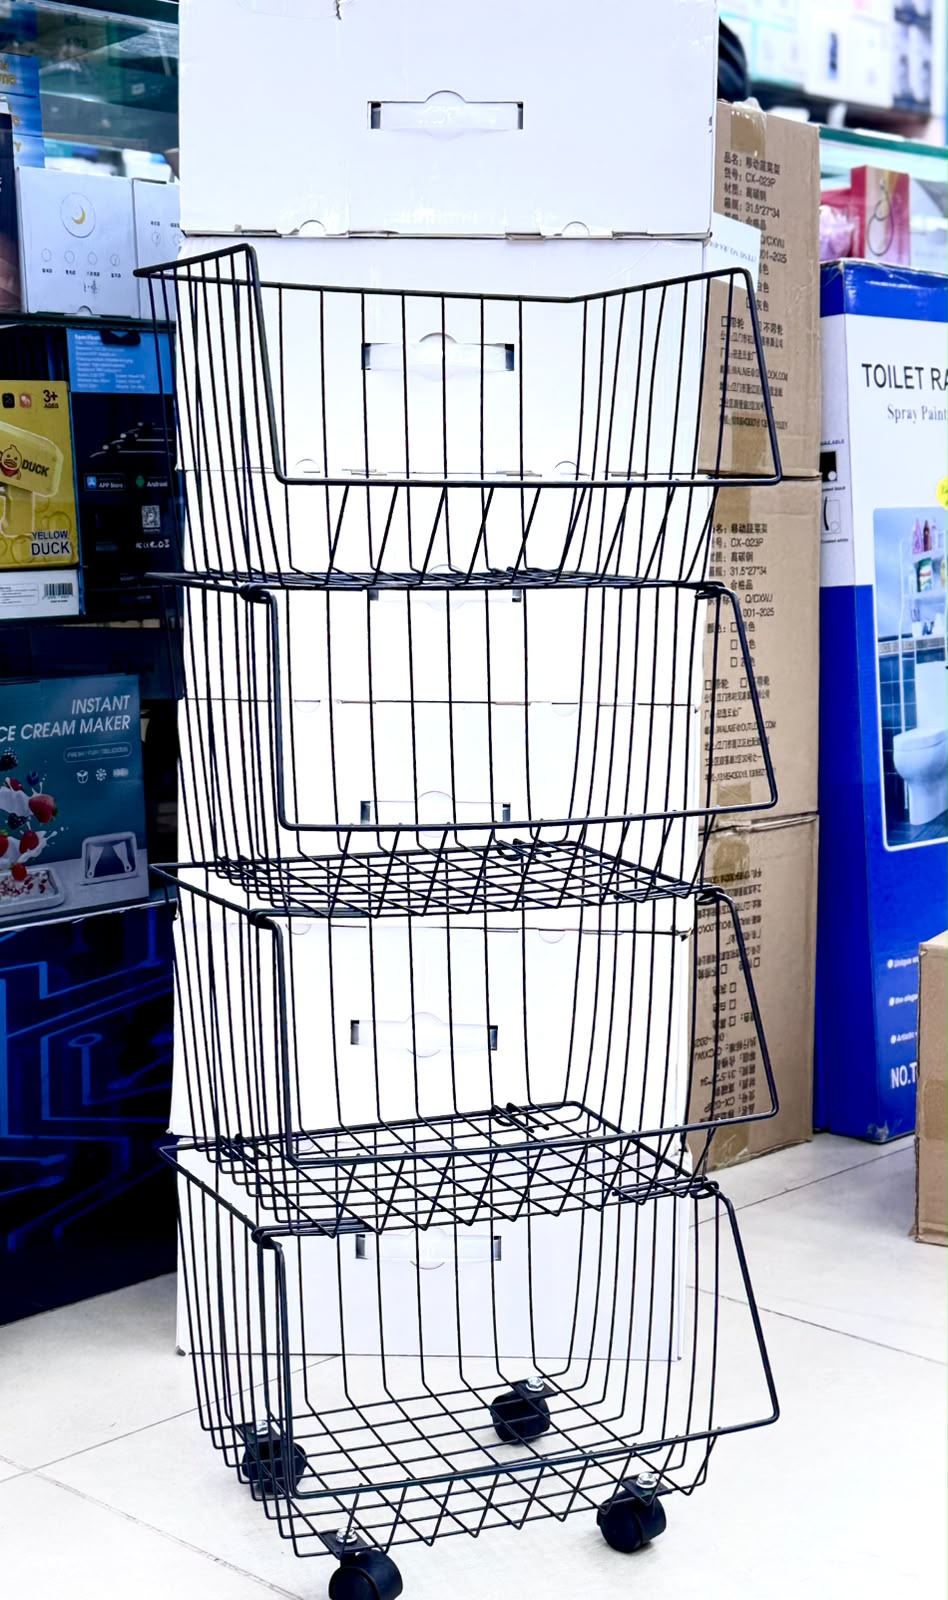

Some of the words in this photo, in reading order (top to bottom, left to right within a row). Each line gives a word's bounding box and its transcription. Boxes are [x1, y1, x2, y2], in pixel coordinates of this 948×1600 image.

[861, 363, 924, 390] TOILET
[43, 389, 58, 402] 3+
[887, 404, 917, 424] Spray
[22, 459, 50, 477] DUCK
[32, 530, 68, 540] YELLOW
[31, 541, 70, 556] DUCK
[71, 695, 130, 715] INSTANT
[21, 719, 76, 740] CREAM
[80, 714, 130, 734] MAKER
